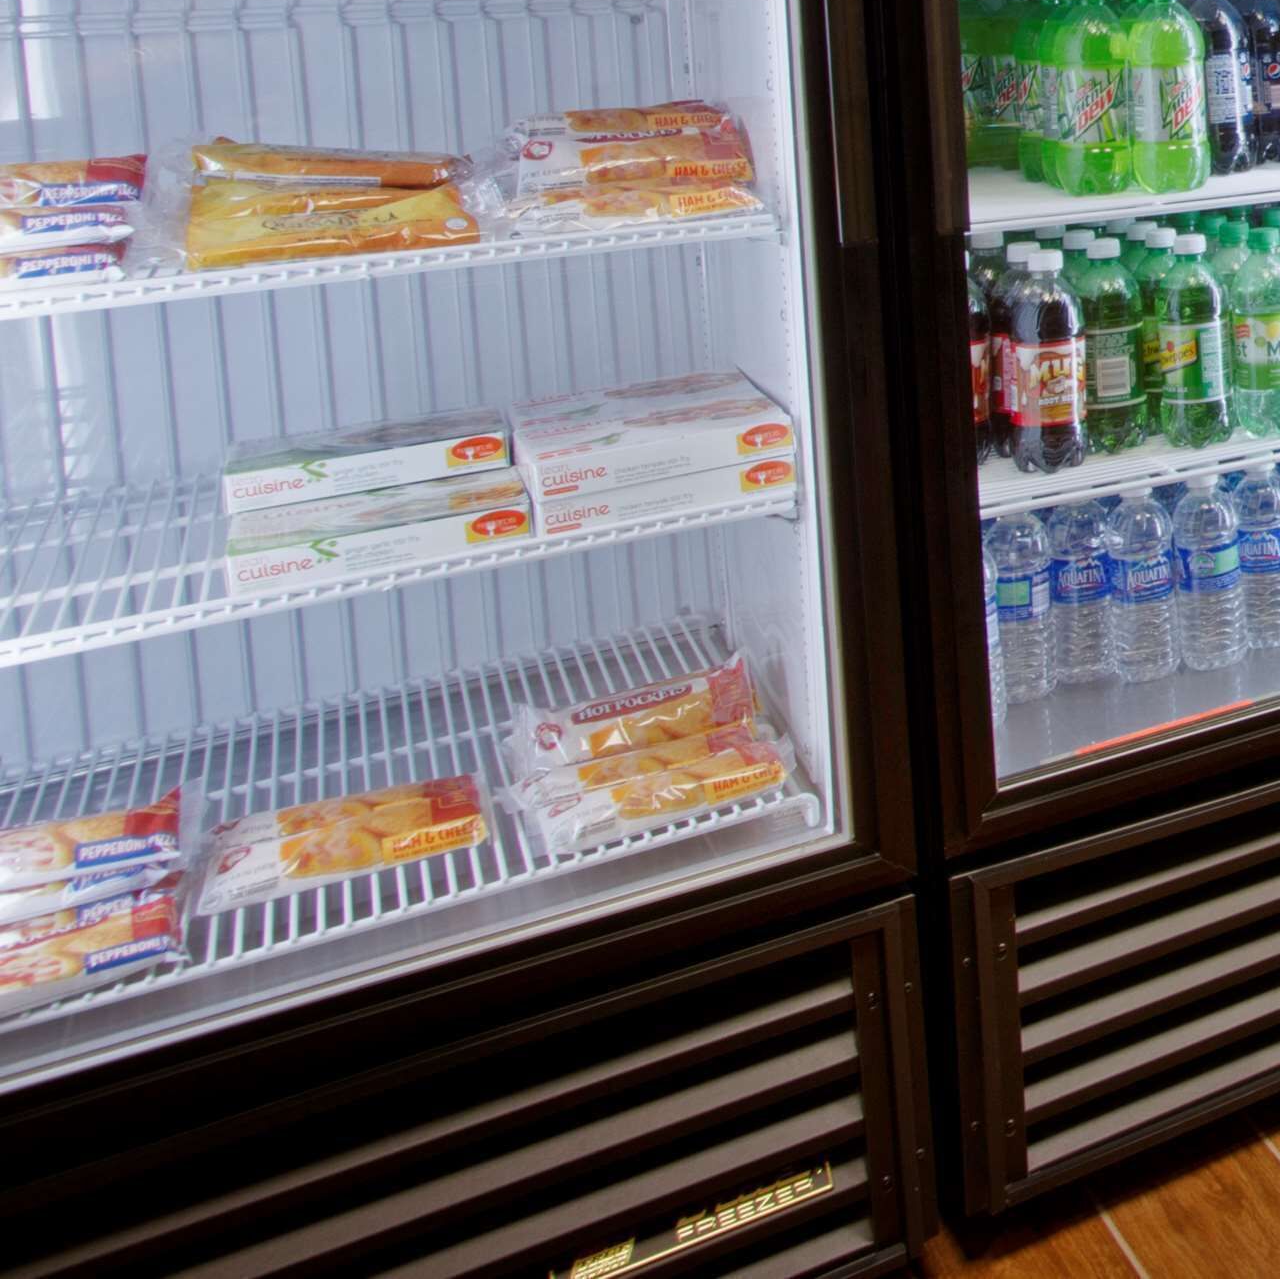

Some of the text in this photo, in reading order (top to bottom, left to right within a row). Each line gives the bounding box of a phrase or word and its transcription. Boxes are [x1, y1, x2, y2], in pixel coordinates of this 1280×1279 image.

[674, 166, 697, 178] HAM
[678, 193, 703, 207] HAM
[27, 213, 96, 229] PEPPERONI
[541, 466, 608, 488] cuisine
[233, 478, 304, 499] cuisine
[545, 504, 610, 526] cuisine
[237, 557, 314, 583] cuisine
[577, 685, 689, 720] HOT POCKETS
[713, 776, 739, 793] HAM
[79, 838, 146, 862] PEPPERONI
[675, 1176, 815, 1242] FREEZER
